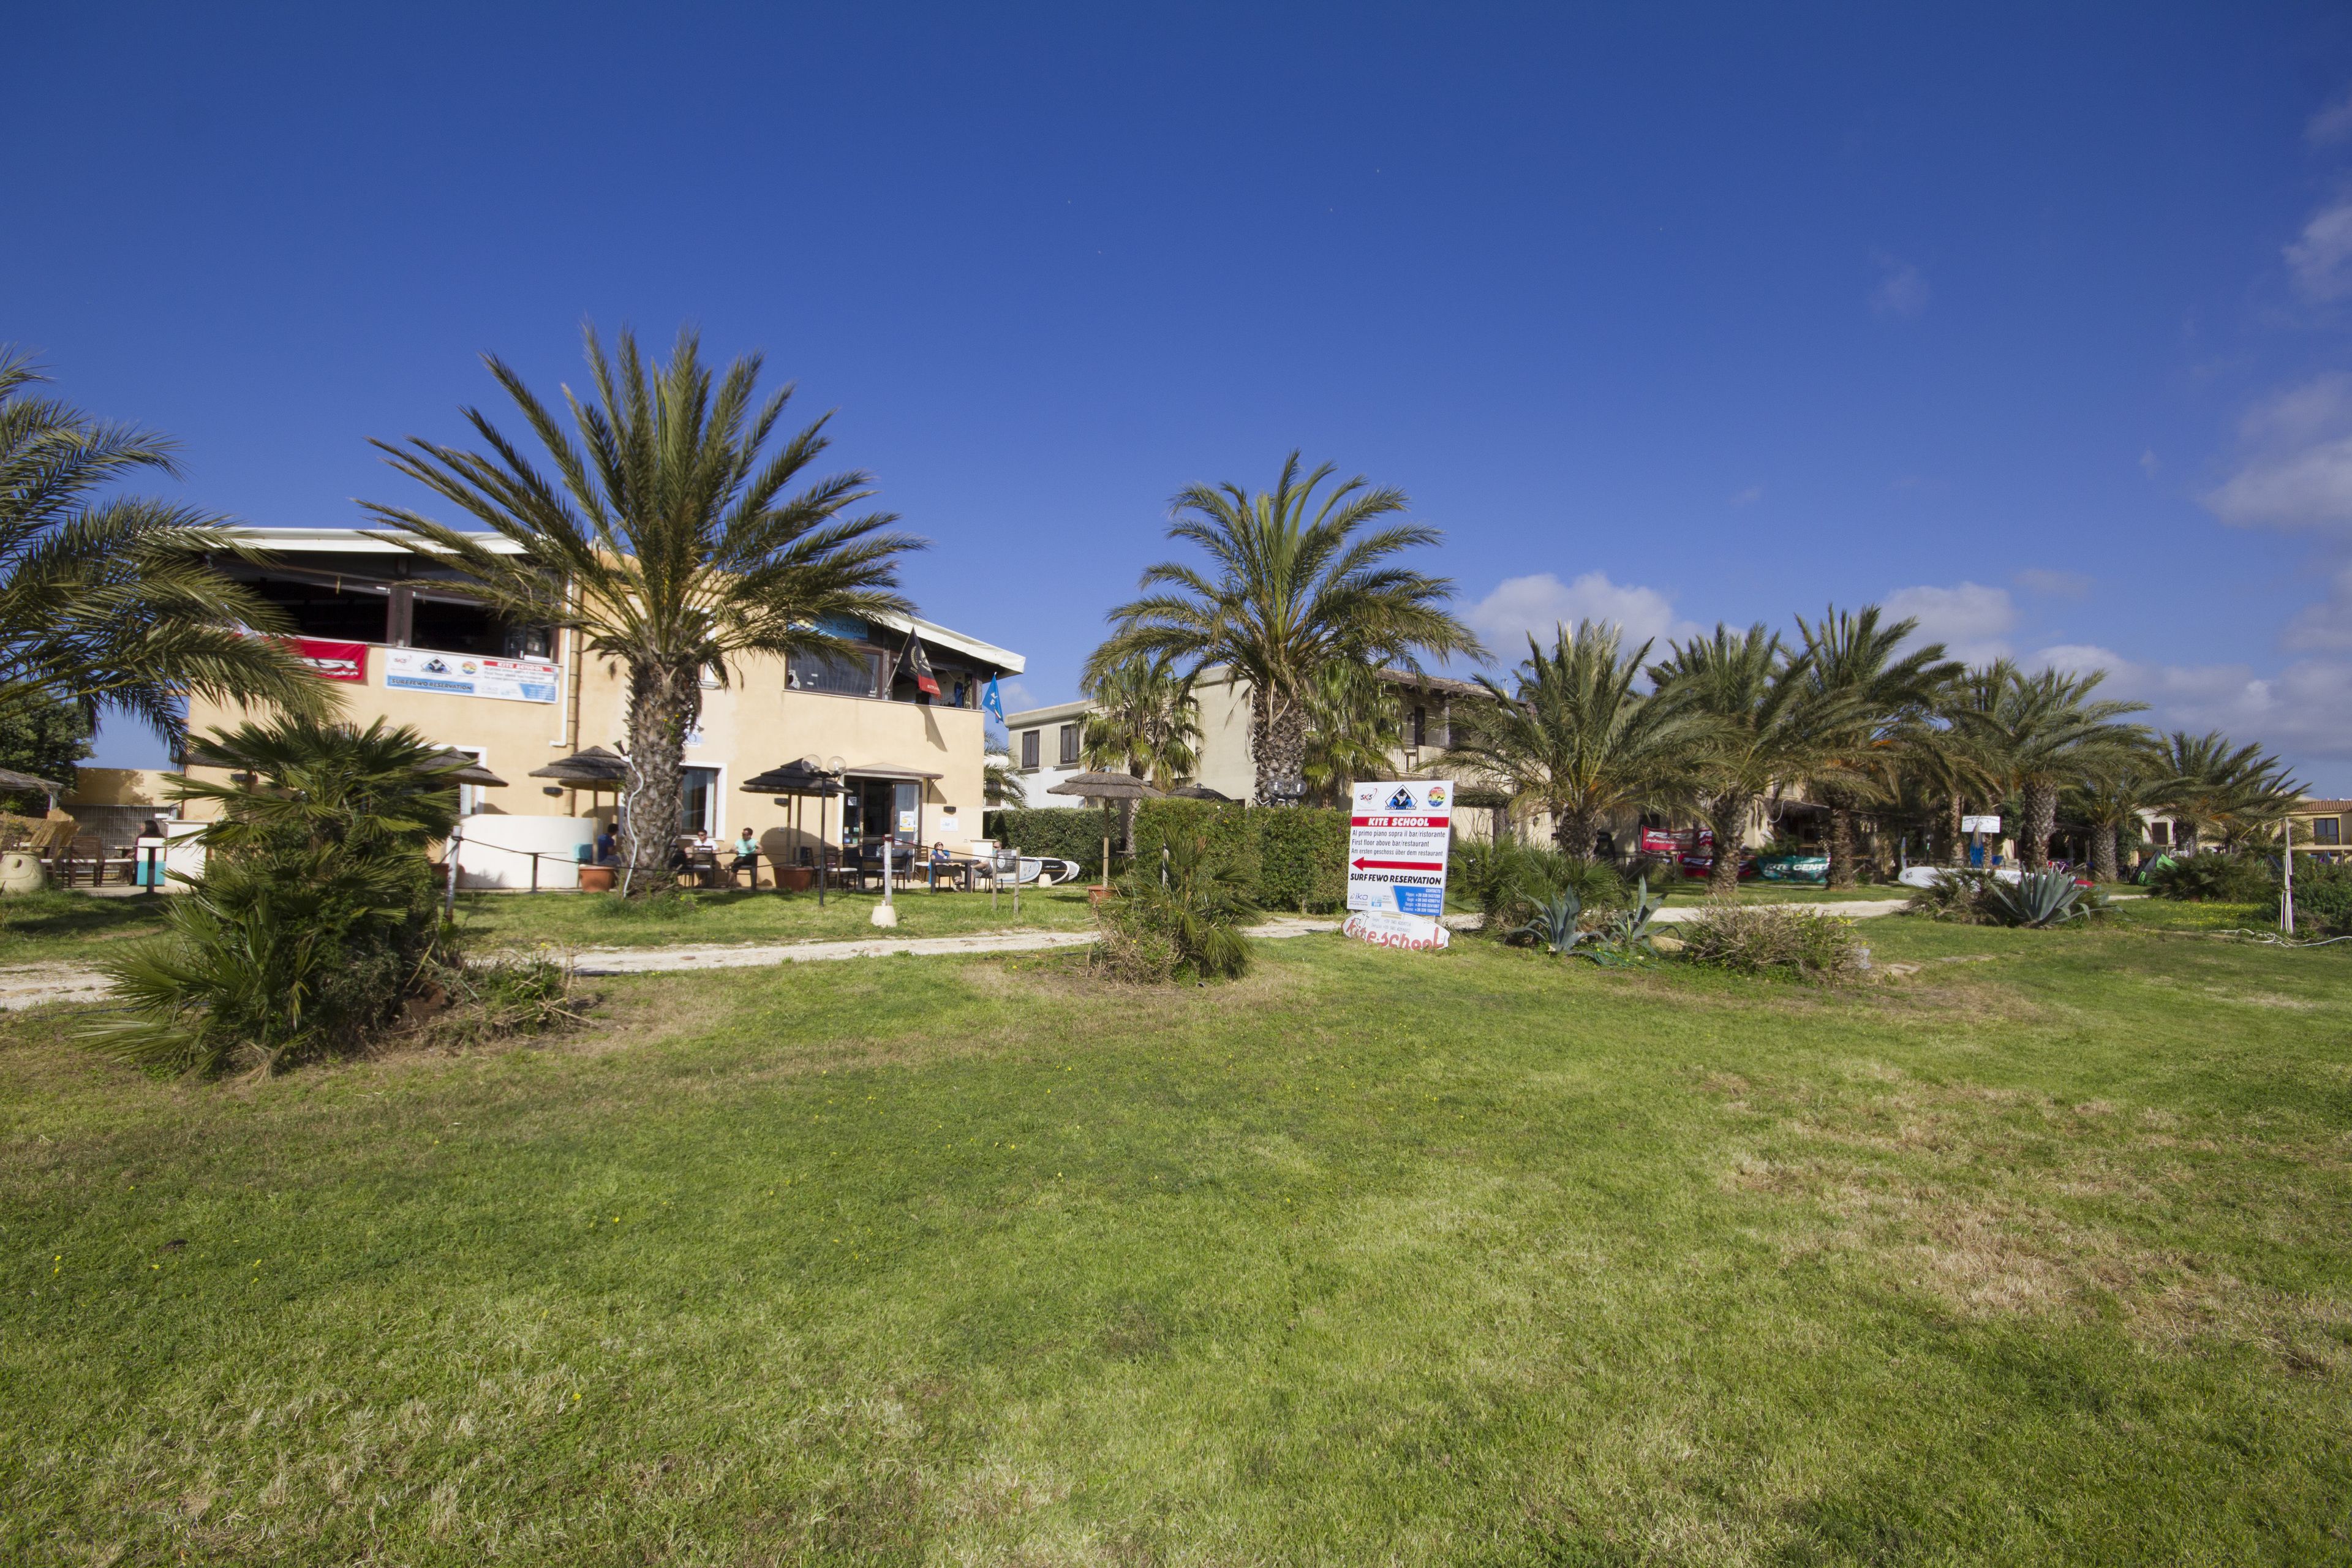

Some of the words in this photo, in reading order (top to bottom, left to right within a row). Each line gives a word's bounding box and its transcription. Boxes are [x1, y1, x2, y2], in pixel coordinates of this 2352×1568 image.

[837, 621, 866, 634] school
[516, 663, 544, 671] SCHOOL
[1368, 818, 1389, 826] KITE
[1391, 818, 1430, 826] SCHOOL
[1389, 875, 1442, 885] RESERVATION
